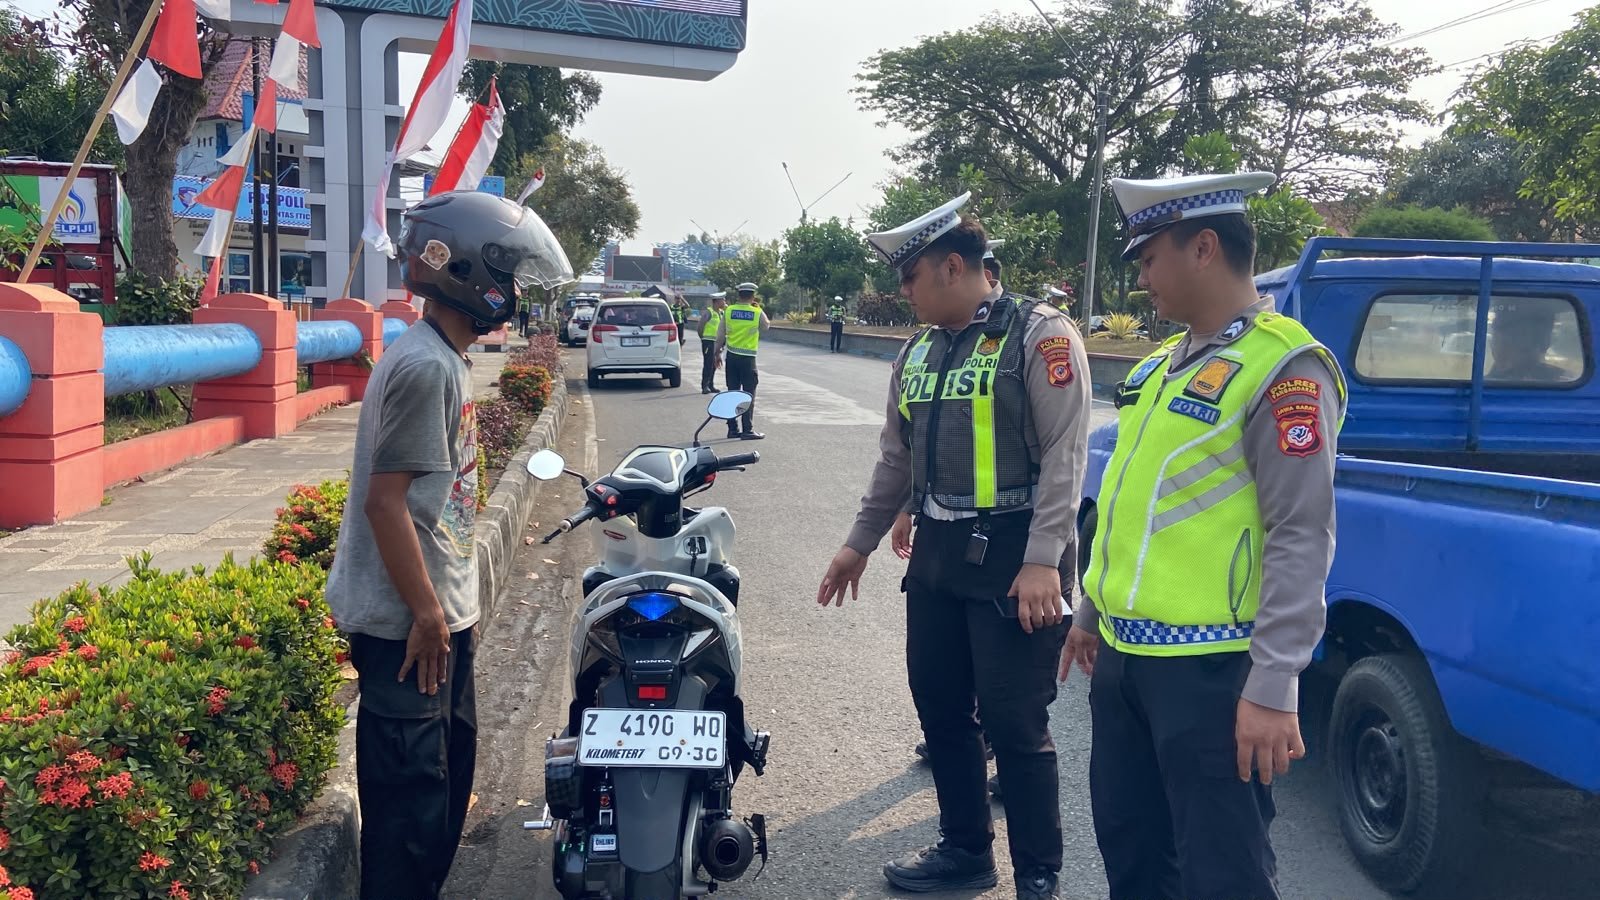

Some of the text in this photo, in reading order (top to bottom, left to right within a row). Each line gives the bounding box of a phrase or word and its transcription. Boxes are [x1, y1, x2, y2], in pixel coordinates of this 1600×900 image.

[732, 311, 754, 319] POLISI
[1040, 338, 1068, 351] POLRES
[964, 359, 998, 369] POLRI
[901, 370, 989, 401] POLISI
[1270, 380, 1316, 395] POLRES
[1171, 400, 1217, 422] POLRI
[1277, 404, 1317, 416] JAWA BARAT
[585, 714, 598, 735] Z
[620, 714, 674, 736] 4190
